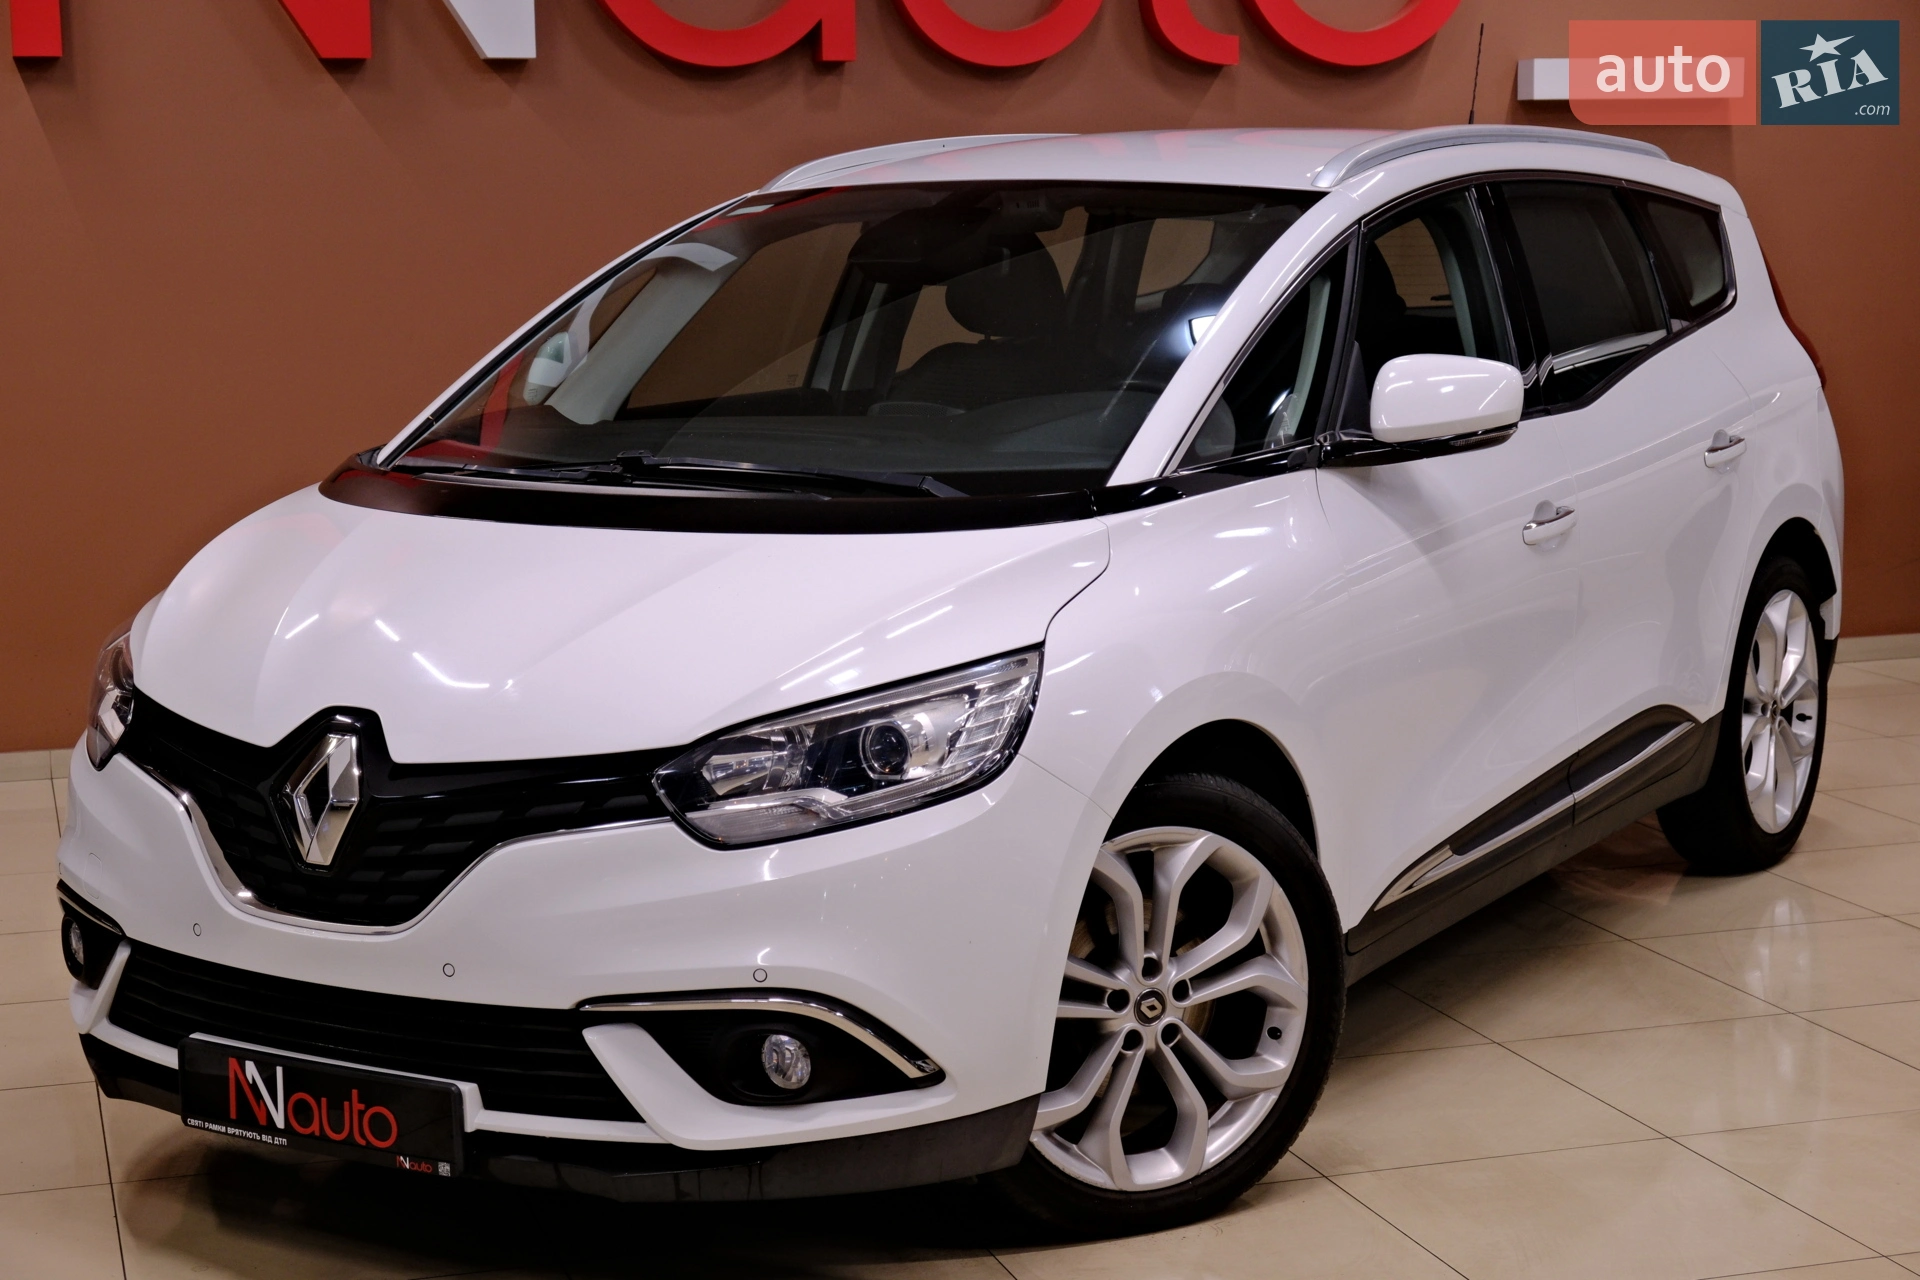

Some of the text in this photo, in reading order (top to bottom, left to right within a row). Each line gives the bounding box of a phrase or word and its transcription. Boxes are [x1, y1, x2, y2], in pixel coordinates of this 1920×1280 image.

[187, 1118, 288, 1146] СВЯТІ РАМКИ ВРЯТУЮТЬ ВІД ДТП
